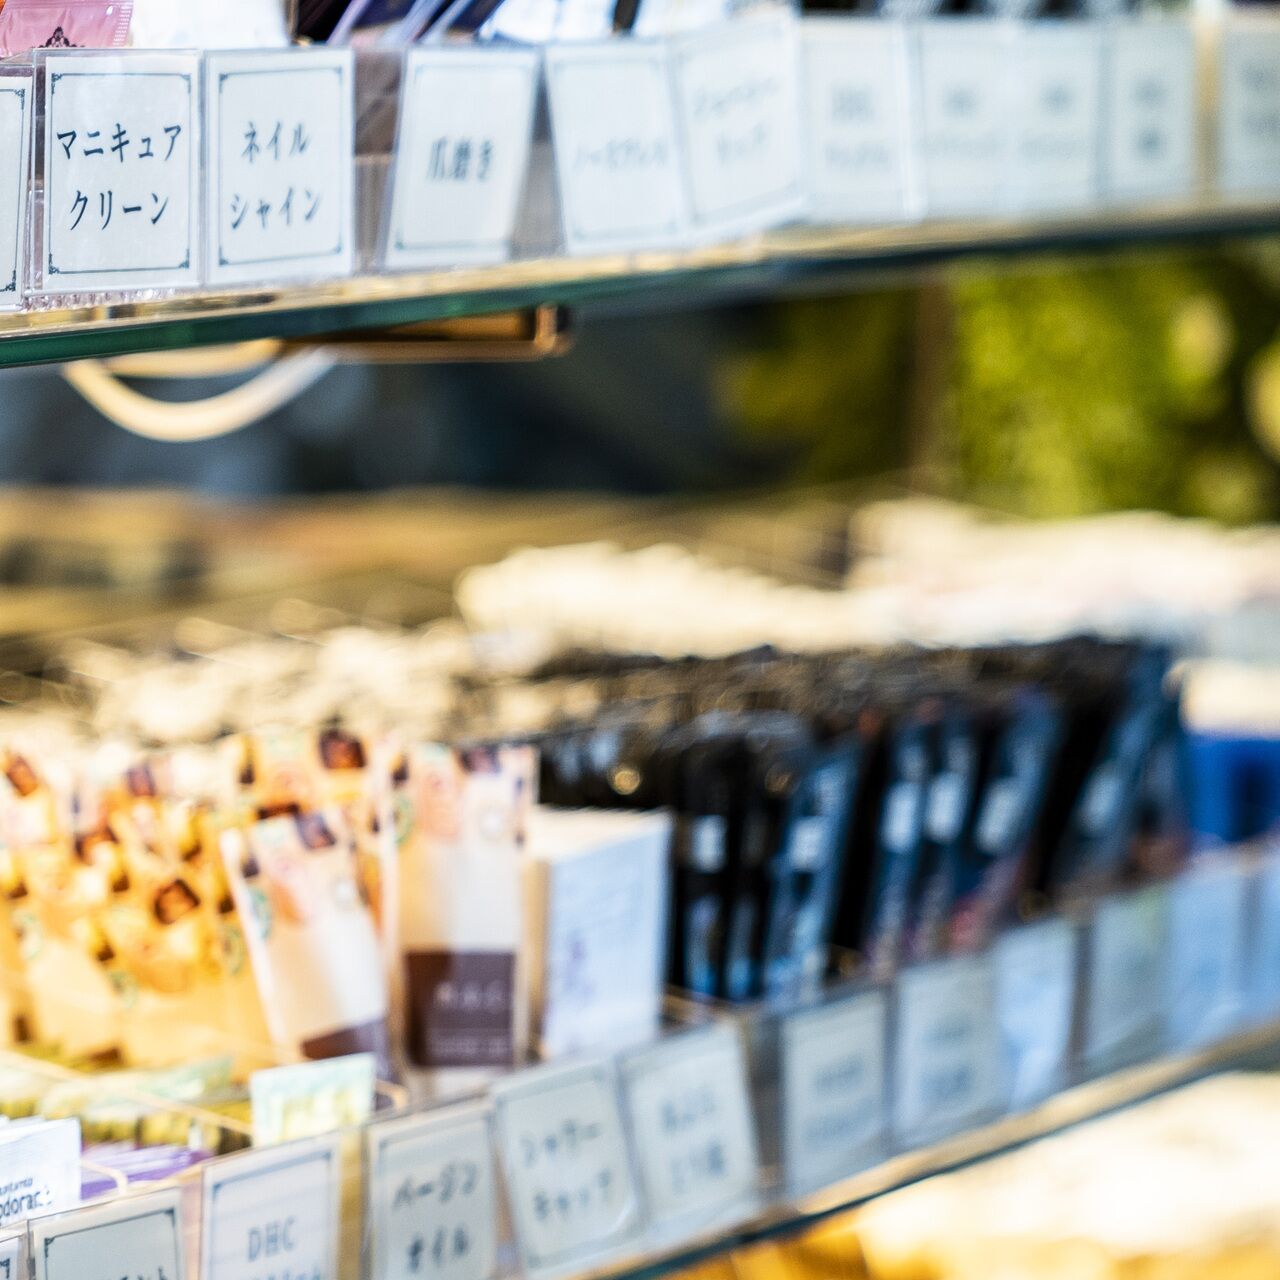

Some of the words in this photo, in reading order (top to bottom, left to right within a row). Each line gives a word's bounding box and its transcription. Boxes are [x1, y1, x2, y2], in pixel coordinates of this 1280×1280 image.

[55, 122, 184, 165] マニキュア
[240, 119, 311, 165] ネイル
[69, 189, 171, 233] クリーン
[229, 189, 322, 232] シャイン
[247, 1215, 296, 1263] DHC
